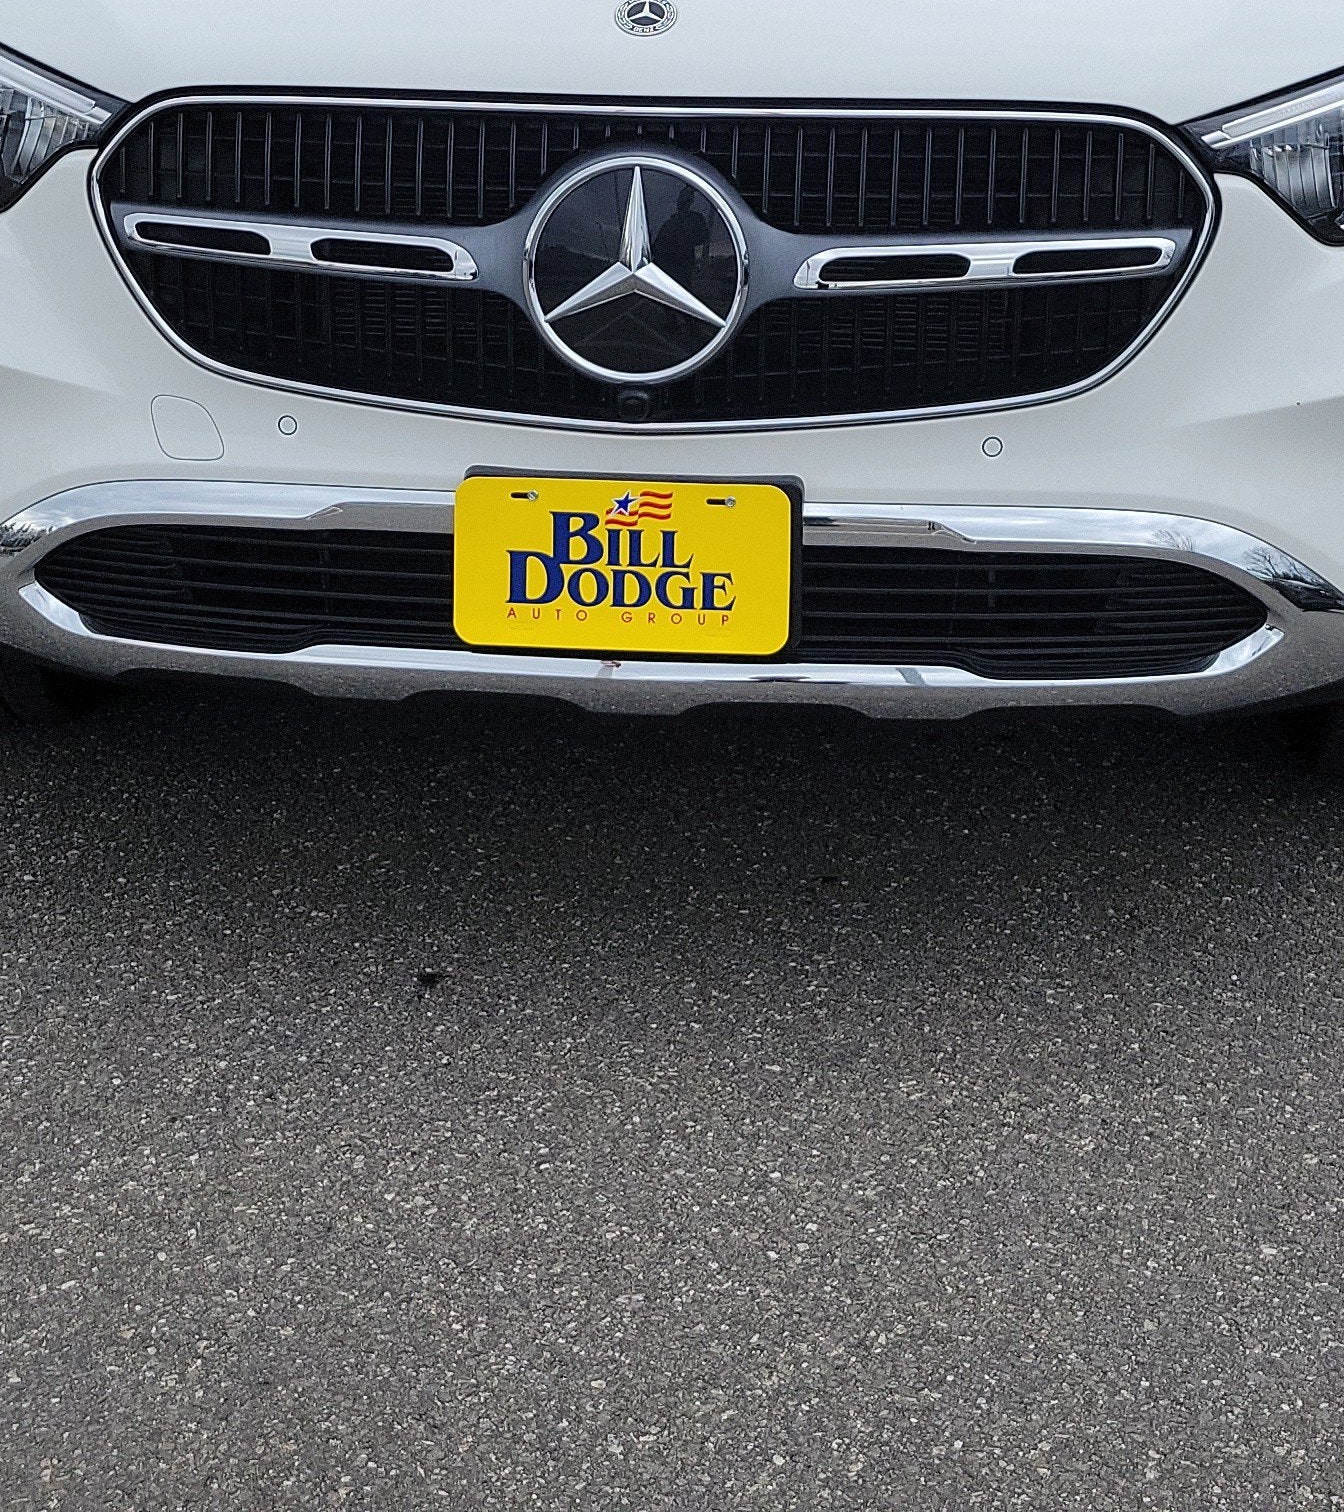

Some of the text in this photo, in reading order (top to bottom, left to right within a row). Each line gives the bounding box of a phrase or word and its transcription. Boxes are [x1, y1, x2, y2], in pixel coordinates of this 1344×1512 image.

[549, 511, 695, 569] BILL
[506, 550, 737, 611] DODGE
[506, 607, 731, 626] AUTO GROUP
